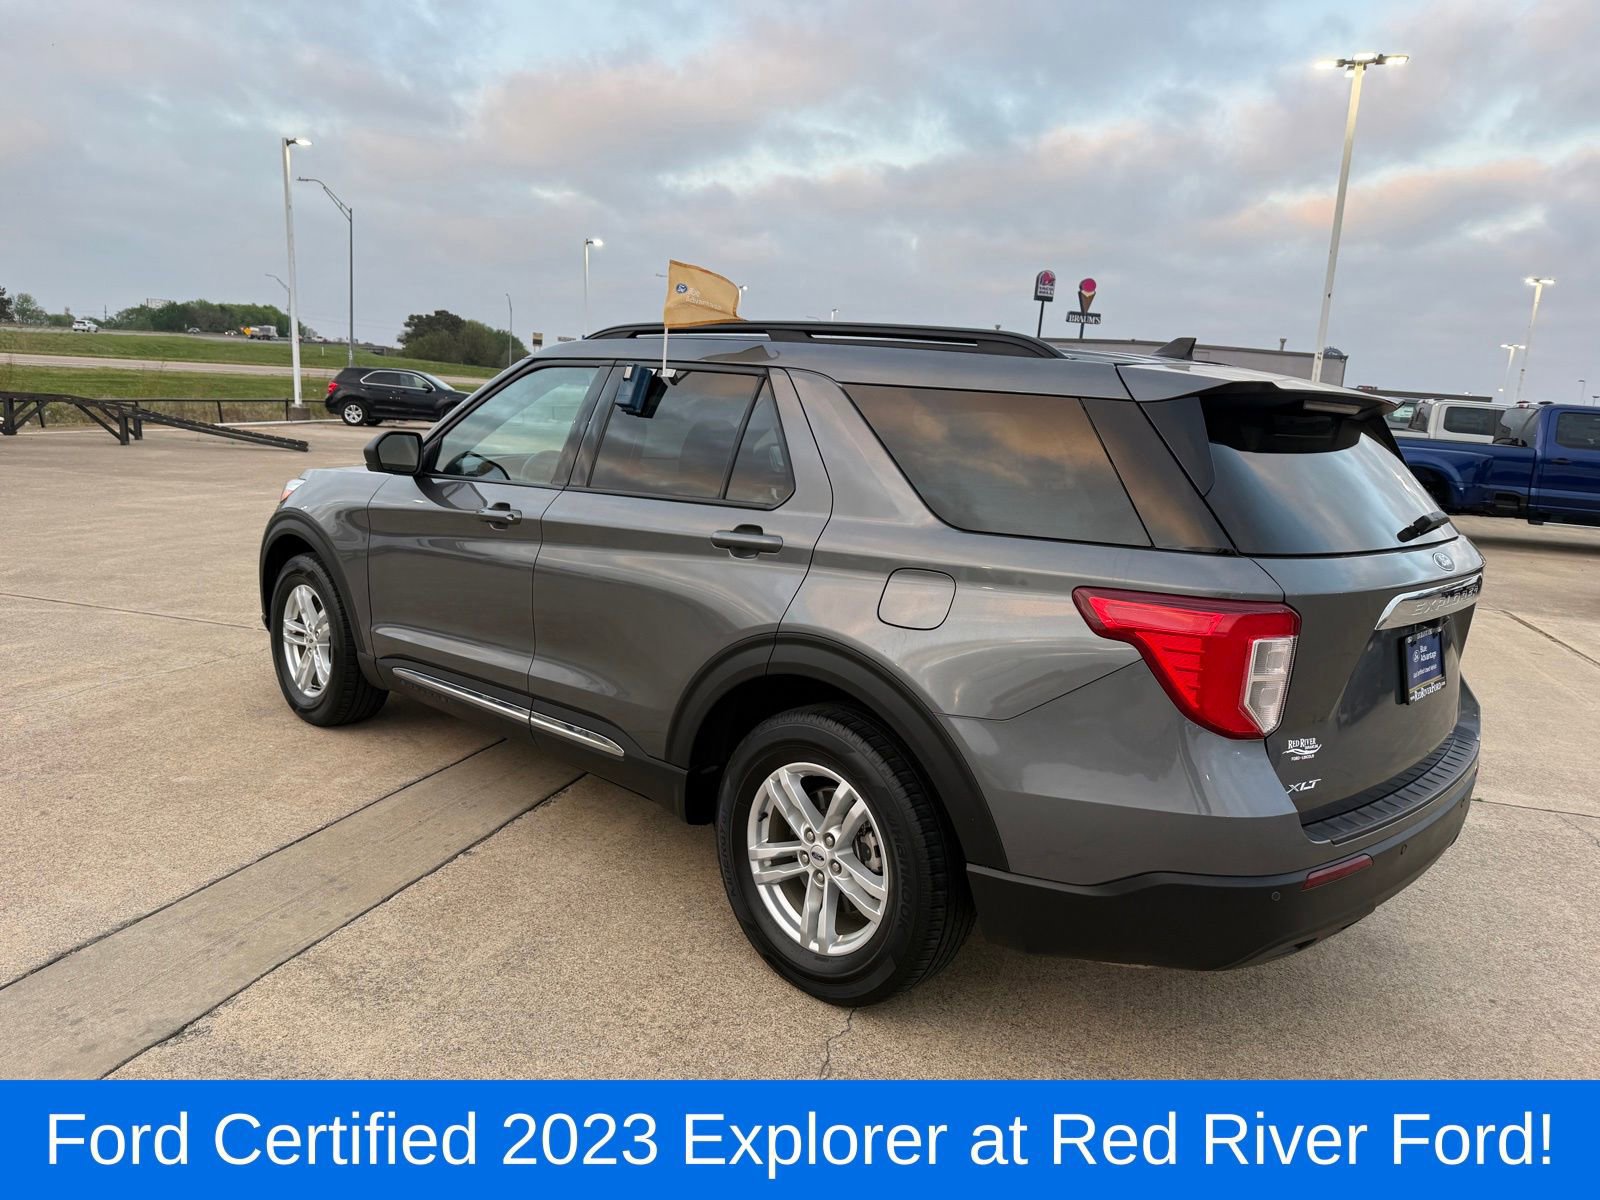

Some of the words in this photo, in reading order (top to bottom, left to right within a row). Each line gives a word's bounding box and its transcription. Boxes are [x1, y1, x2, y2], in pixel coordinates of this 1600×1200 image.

[1288, 739, 1300, 749] RED
[1300, 737, 1316, 748] RIVER
[1286, 778, 1322, 794] XLT
